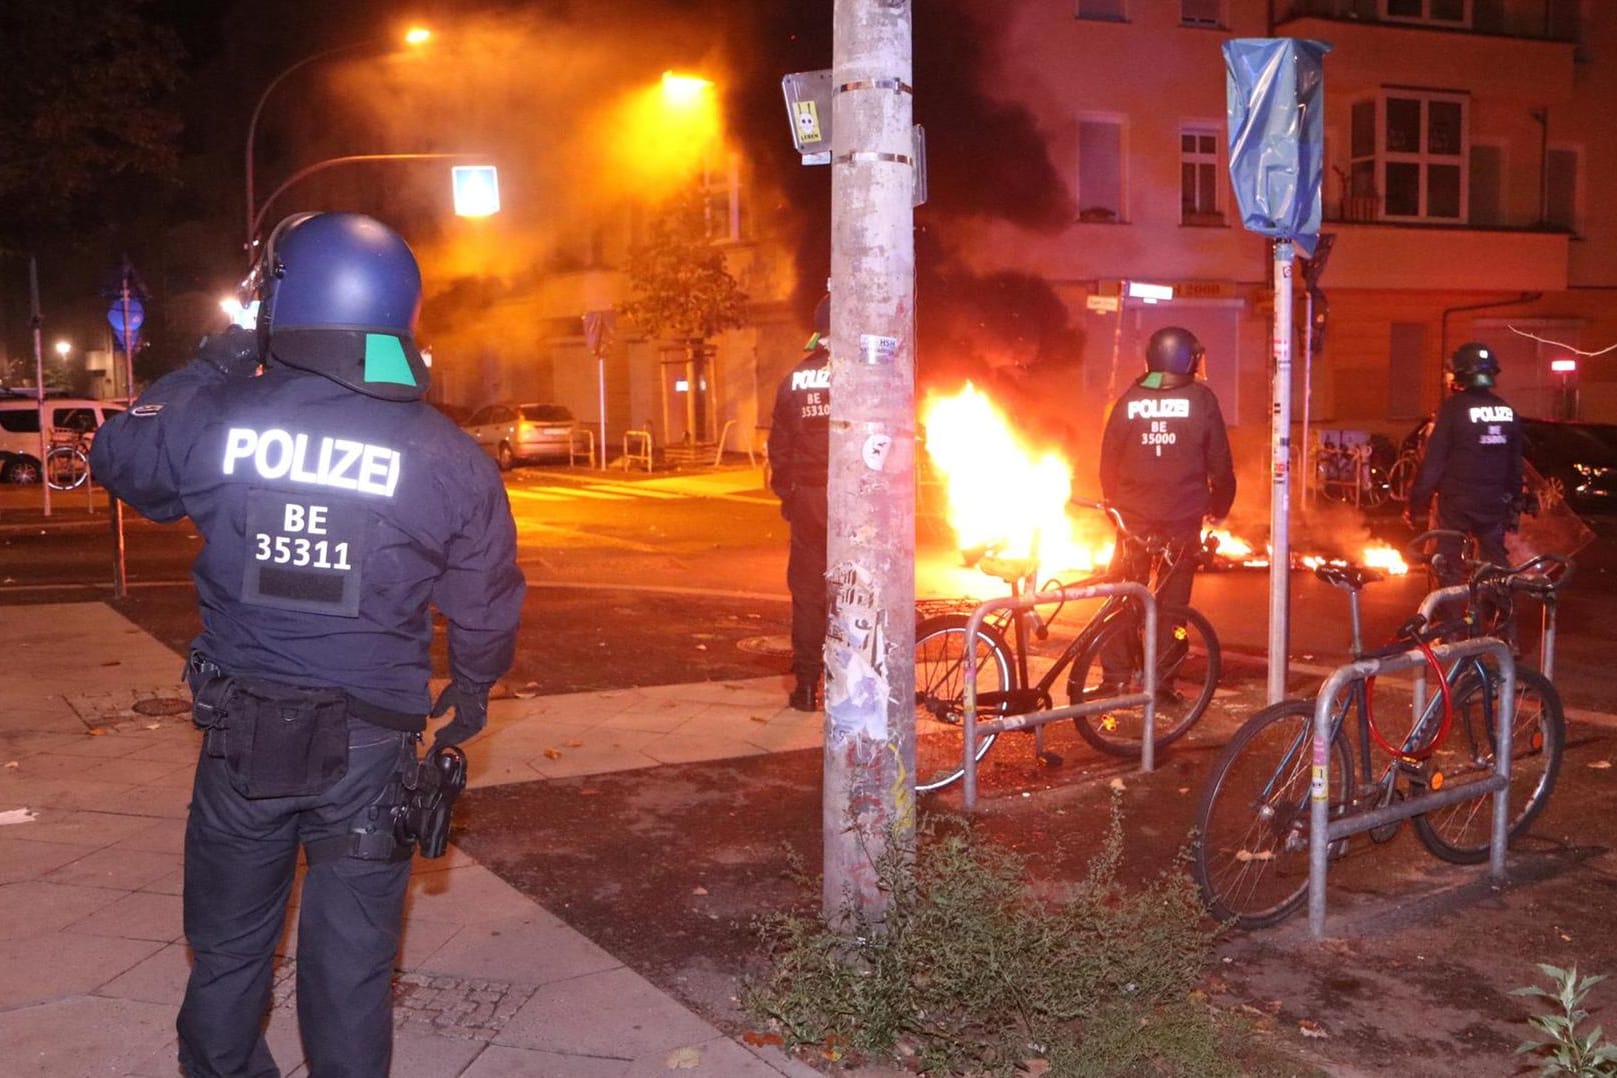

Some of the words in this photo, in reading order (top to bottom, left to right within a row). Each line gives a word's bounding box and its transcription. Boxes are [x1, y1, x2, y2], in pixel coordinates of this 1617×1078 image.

[792, 369, 831, 391] POLIZ
[807, 392, 821, 405] BE
[801, 404, 830, 418] 35310
[1128, 399, 1190, 420] POLIZEI
[1151, 421, 1168, 433] BE
[1141, 433, 1176, 445] 35000
[222, 427, 401, 498] POLIZEI
[283, 503, 329, 535] BE
[255, 533, 351, 570] 35311
